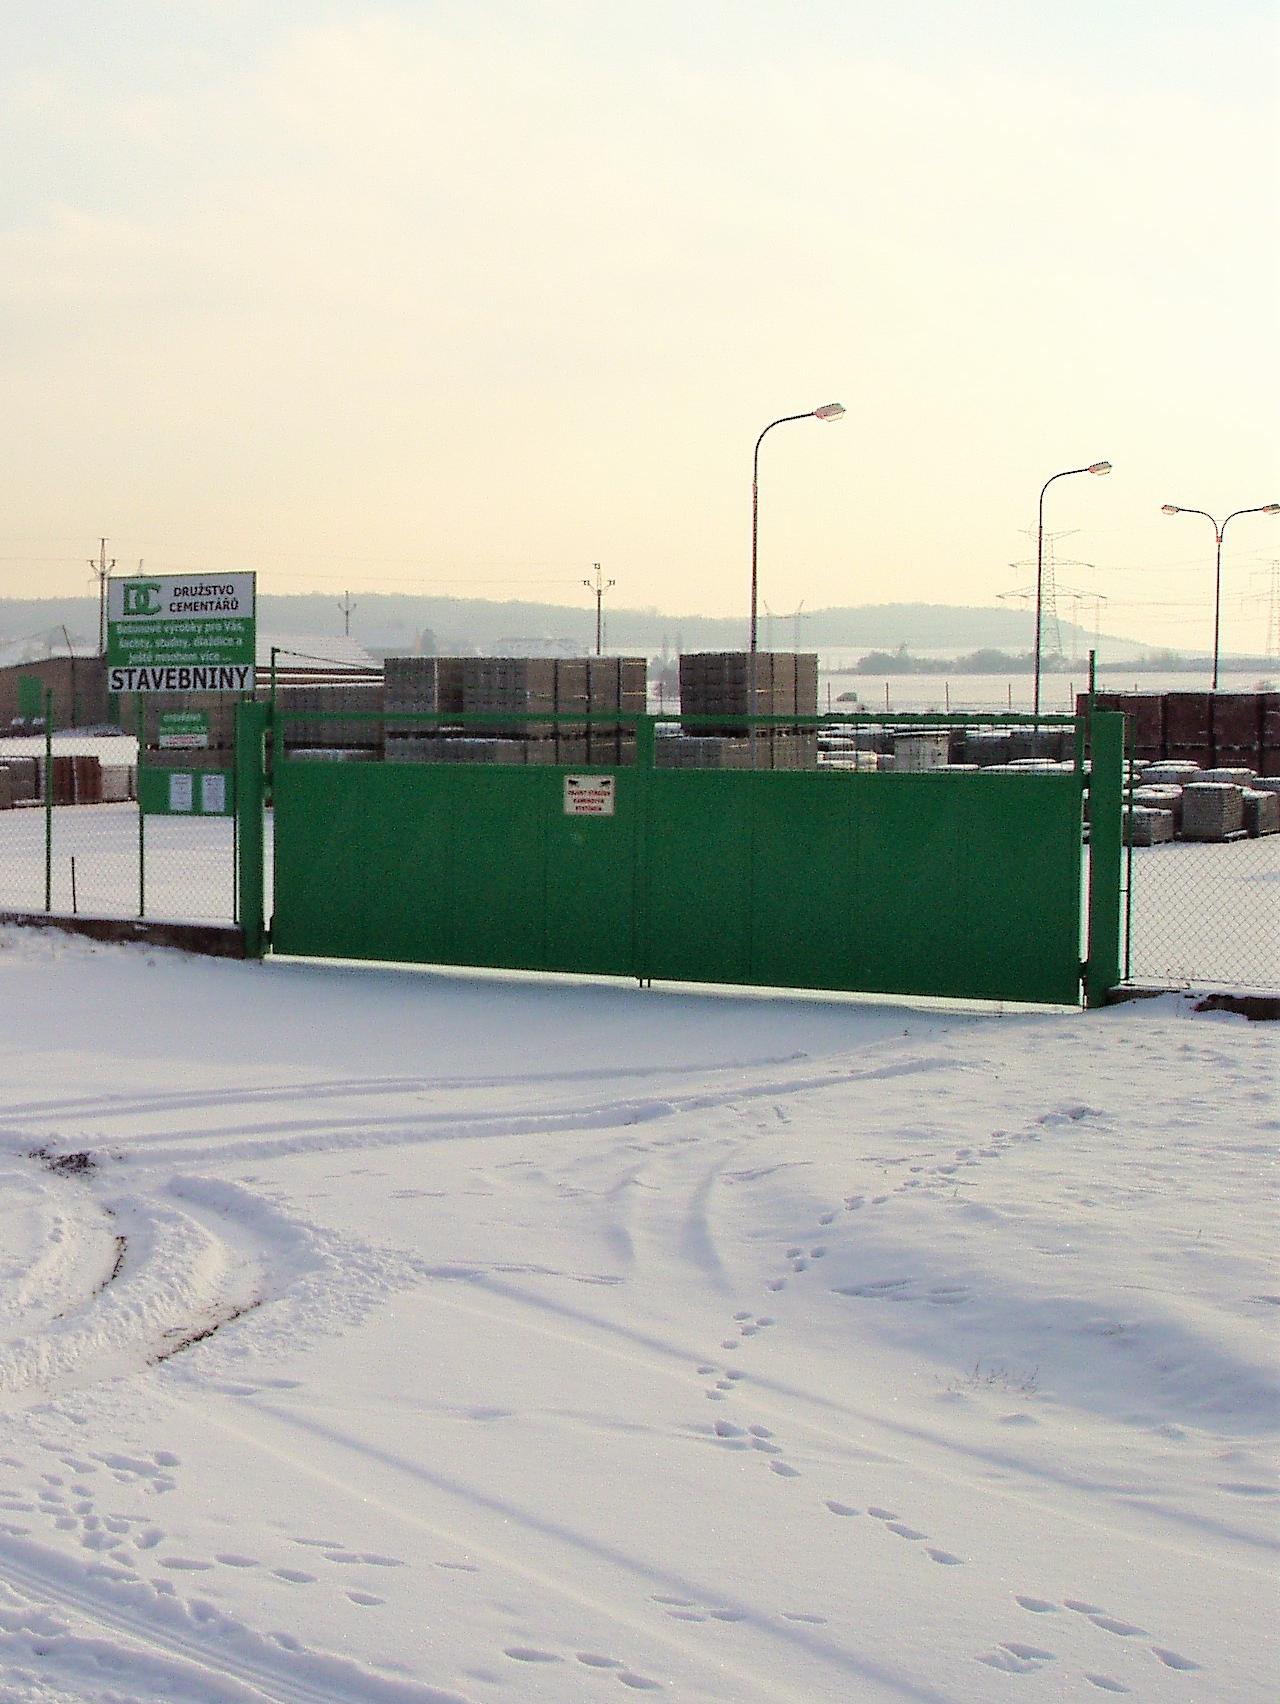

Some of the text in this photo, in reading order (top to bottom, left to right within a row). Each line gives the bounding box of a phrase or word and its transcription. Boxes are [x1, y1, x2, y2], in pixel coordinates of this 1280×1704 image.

[173, 583, 235, 597] DRUŽSTVO
[169, 598, 239, 613] CEMENTÁŘŮ
[111, 667, 249, 691] STAVEBNINY
